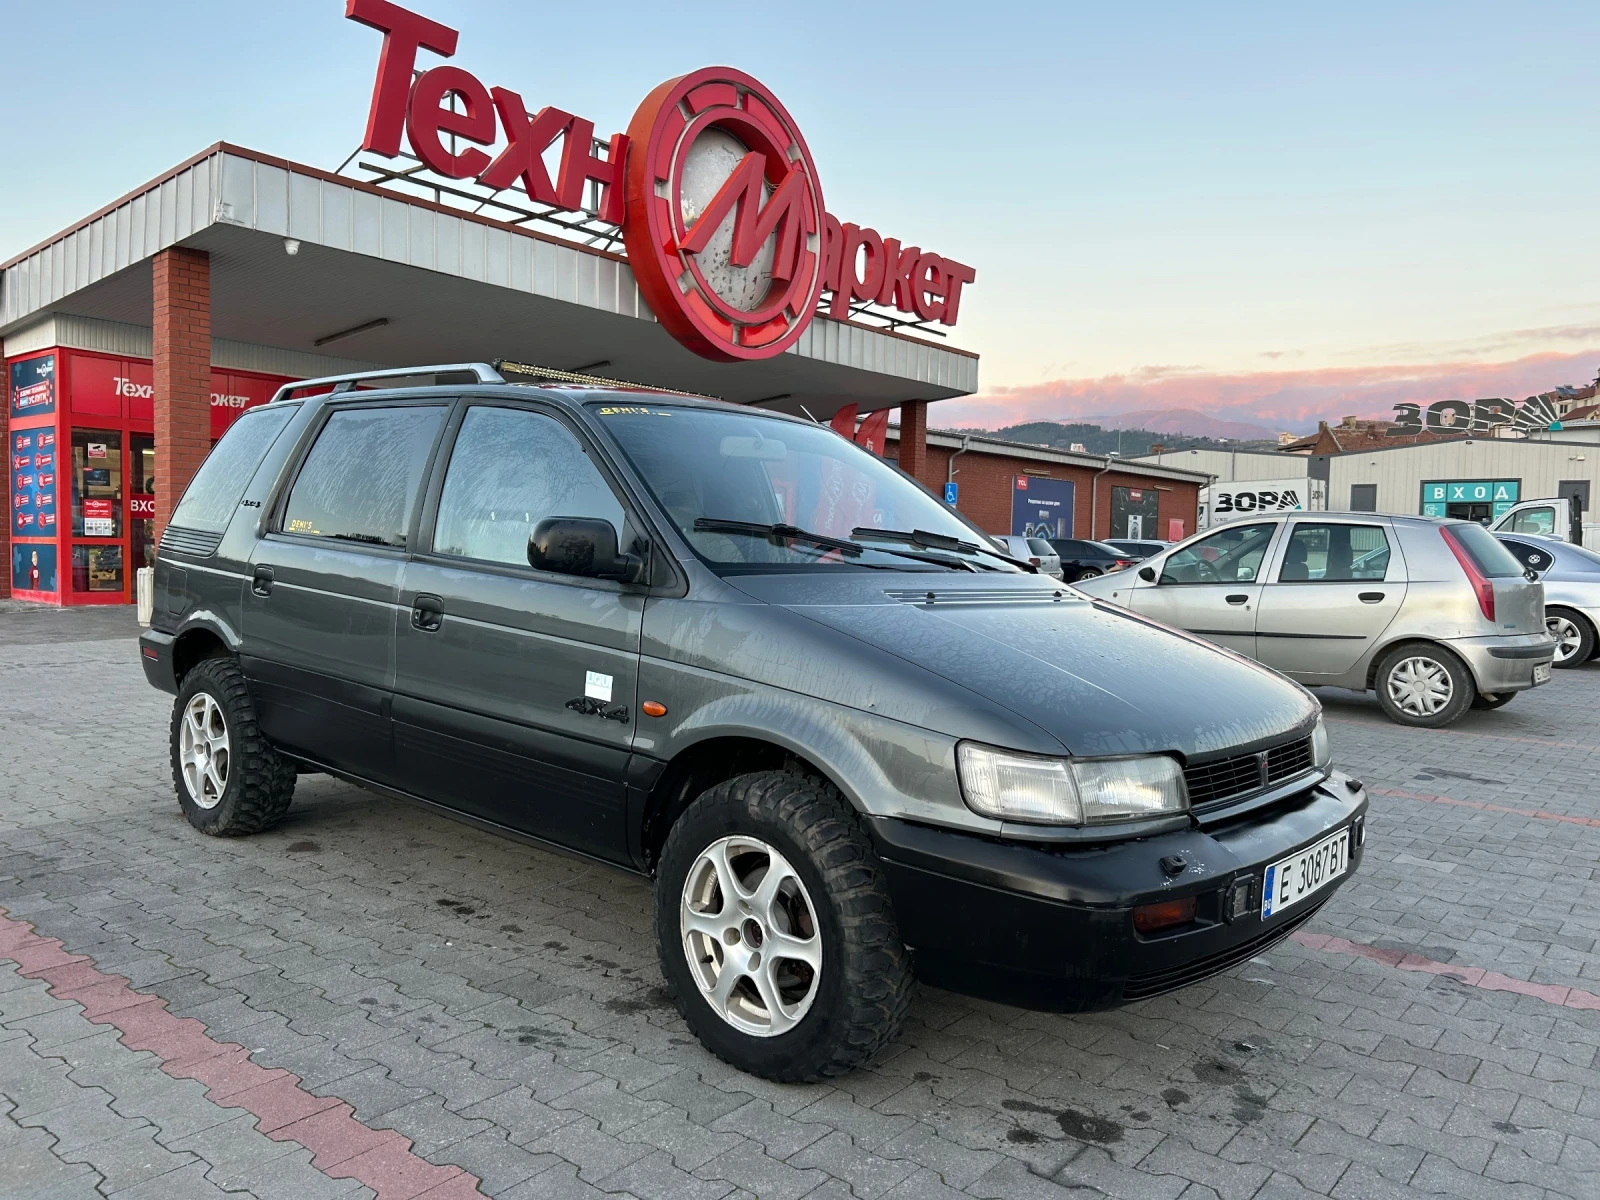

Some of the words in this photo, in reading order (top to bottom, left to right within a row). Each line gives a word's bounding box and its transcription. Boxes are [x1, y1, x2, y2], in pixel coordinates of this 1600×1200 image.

[1384, 395, 1562, 438] ЗОРА
[1215, 490, 1300, 512] ЗОРА
[1434, 486, 1508, 499] ВХОД
[291, 519, 312, 529] DENI'S
[1279, 865, 1291, 904] E
